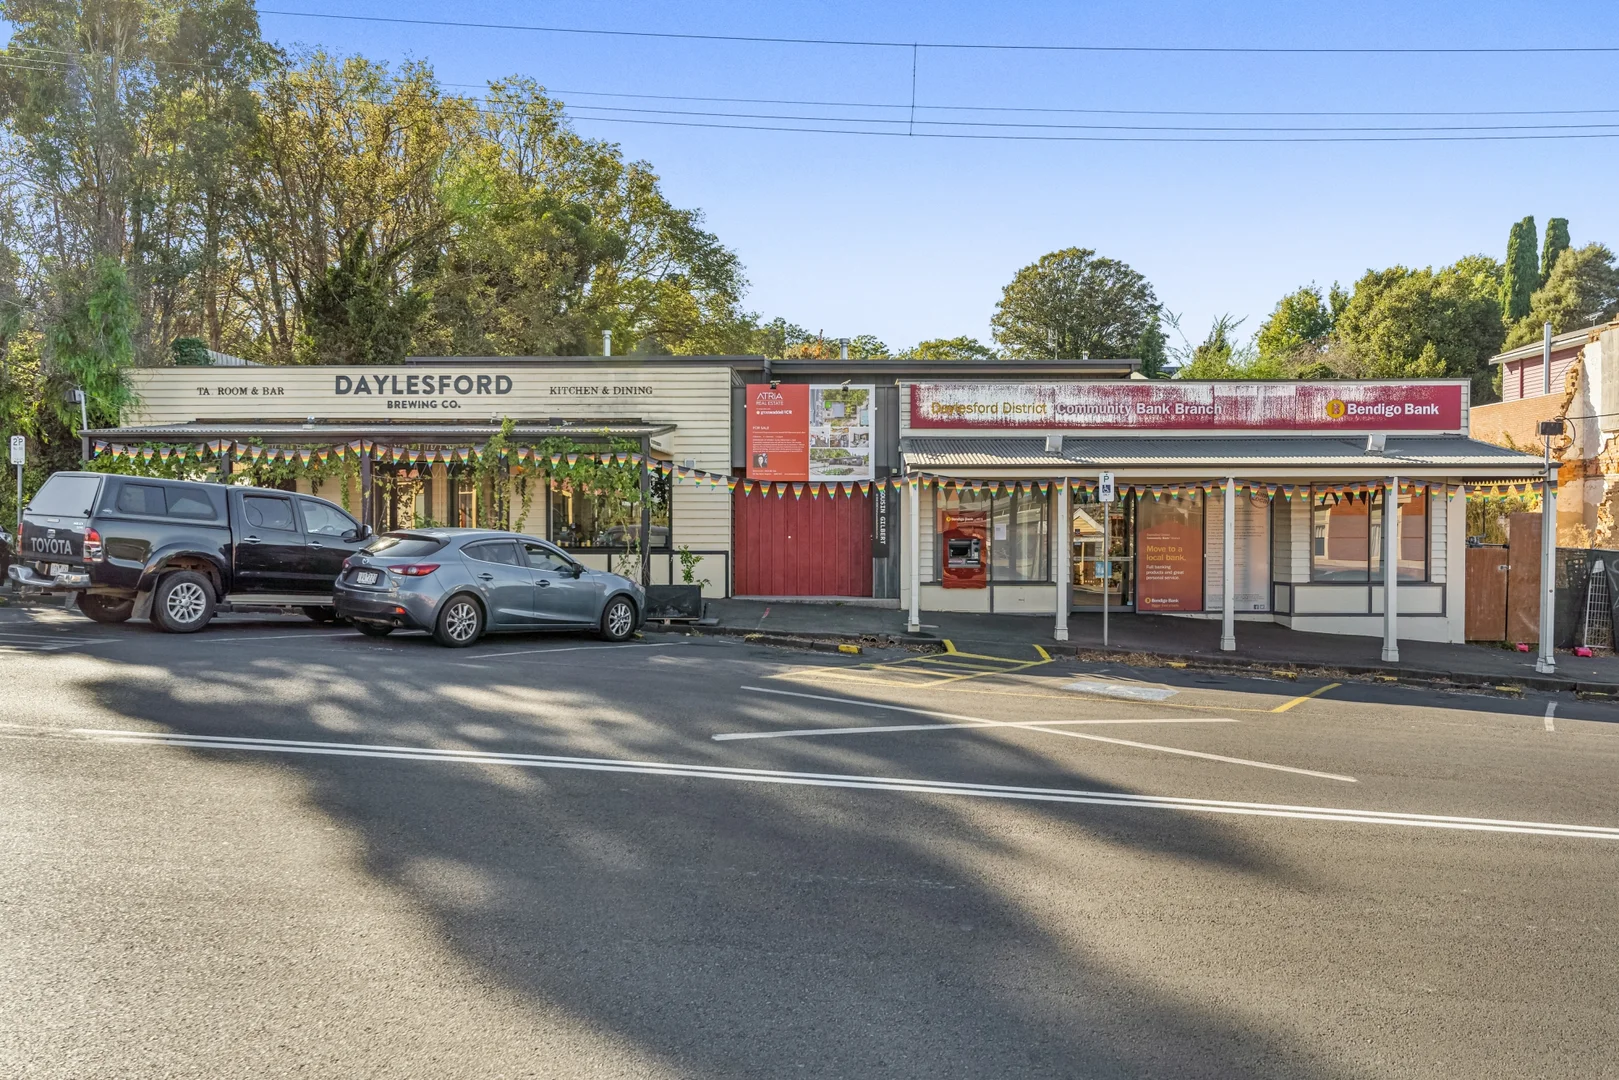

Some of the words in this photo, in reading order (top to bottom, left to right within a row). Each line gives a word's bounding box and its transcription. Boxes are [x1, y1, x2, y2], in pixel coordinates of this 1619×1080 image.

[335, 375, 513, 395] DAYLESFORD
[196, 386, 212, 396] TA
[217, 386, 248, 396] ROOM
[251, 386, 259, 396] &
[262, 386, 285, 396] BAR
[549, 386, 599, 395] KITCHEN
[601, 386, 610, 395] &
[613, 386, 653, 395] DINING
[756, 391, 783, 400] ATRIA
[387, 400, 438, 409] BREWING
[441, 400, 461, 409] CO.
[1002, 402, 1047, 414] District
[1056, 402, 1132, 417] Community
[1136, 402, 1170, 414] Bank
[1175, 402, 1222, 415] Branch
[1347, 403, 1402, 417] Bendigo
[1404, 403, 1440, 415] Bank
[13, 438, 23, 446] 2P
[1103, 475, 1109, 483] P
[31, 537, 72, 555] TOYOTA
